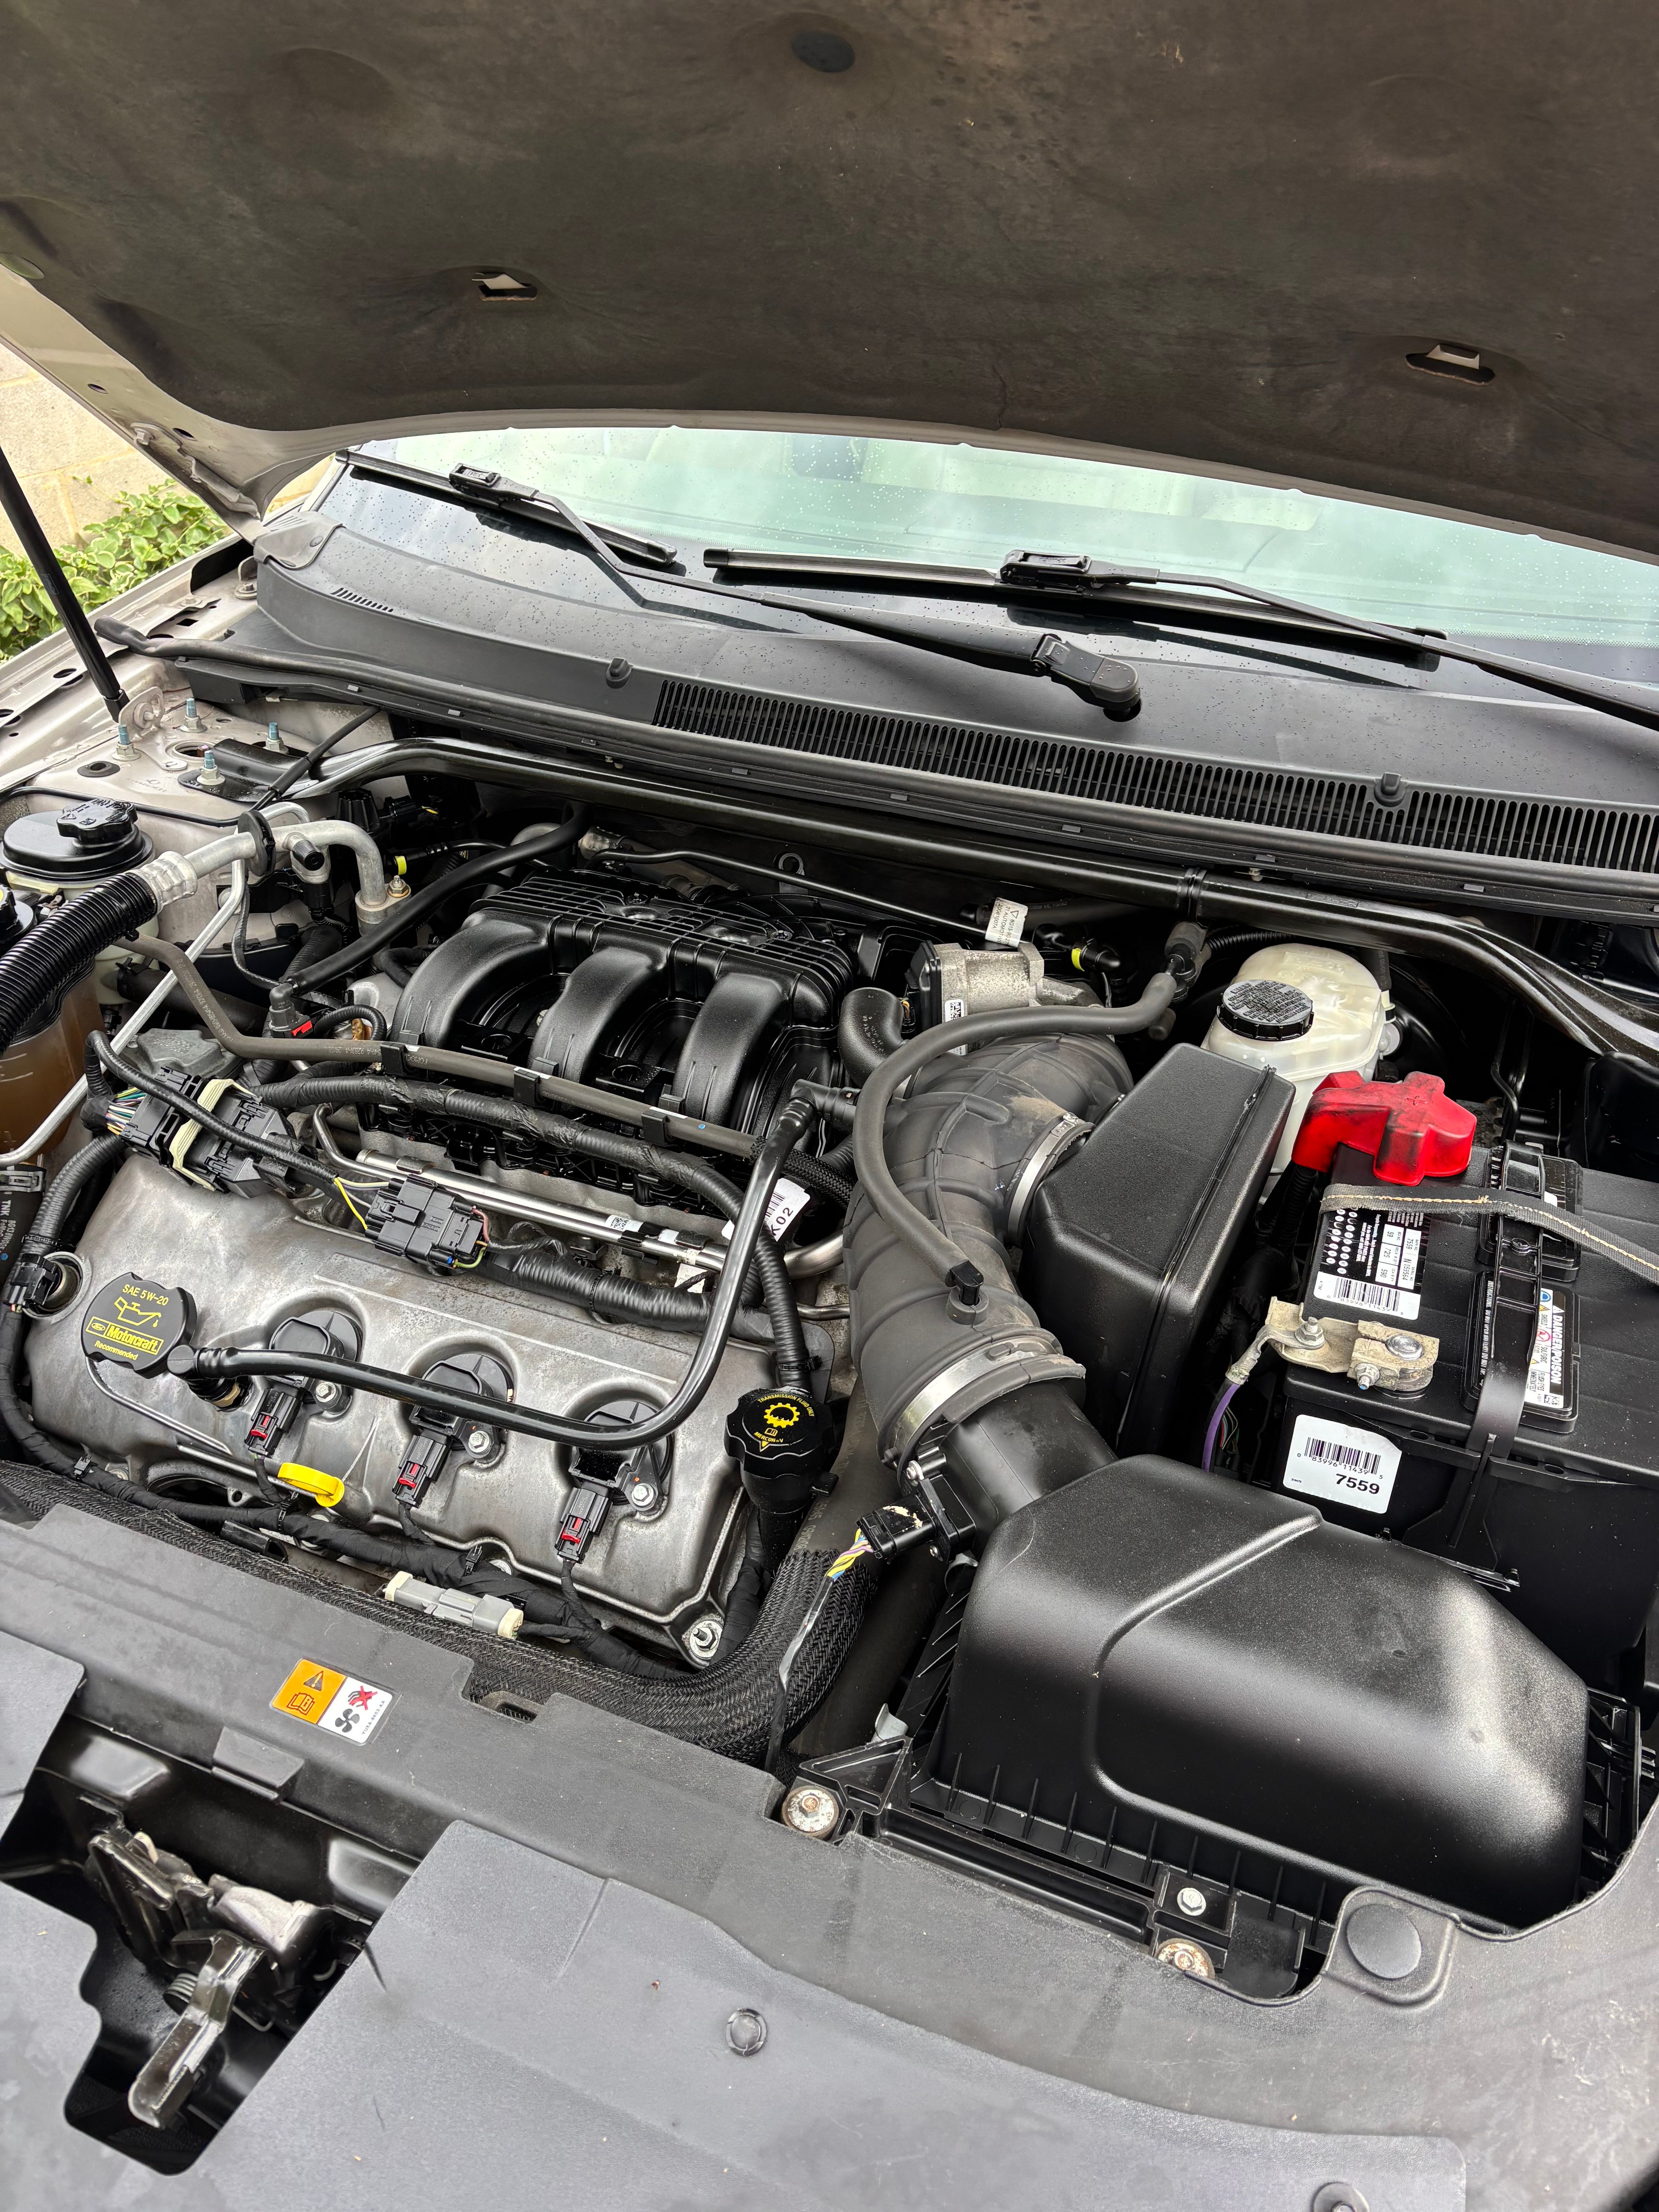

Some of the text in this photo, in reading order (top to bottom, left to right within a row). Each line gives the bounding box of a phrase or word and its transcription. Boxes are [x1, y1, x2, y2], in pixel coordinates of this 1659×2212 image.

[0, 1200, 11, 1216] TNK
[122, 1284, 169, 1307] SAE 5W-20
[106, 1325, 158, 1353] Motorcraft
[1551, 1316, 1564, 1384] DANGER/POISON
[94, 1340, 139, 1361] Recommended
[757, 1394, 815, 1417] TRANSMISSION FLUID ONLY
[1312, 1456, 1338, 1467] 83996
[1343, 1464, 1369, 1475] 11439
[1336, 1473, 1380, 1494] 7559
